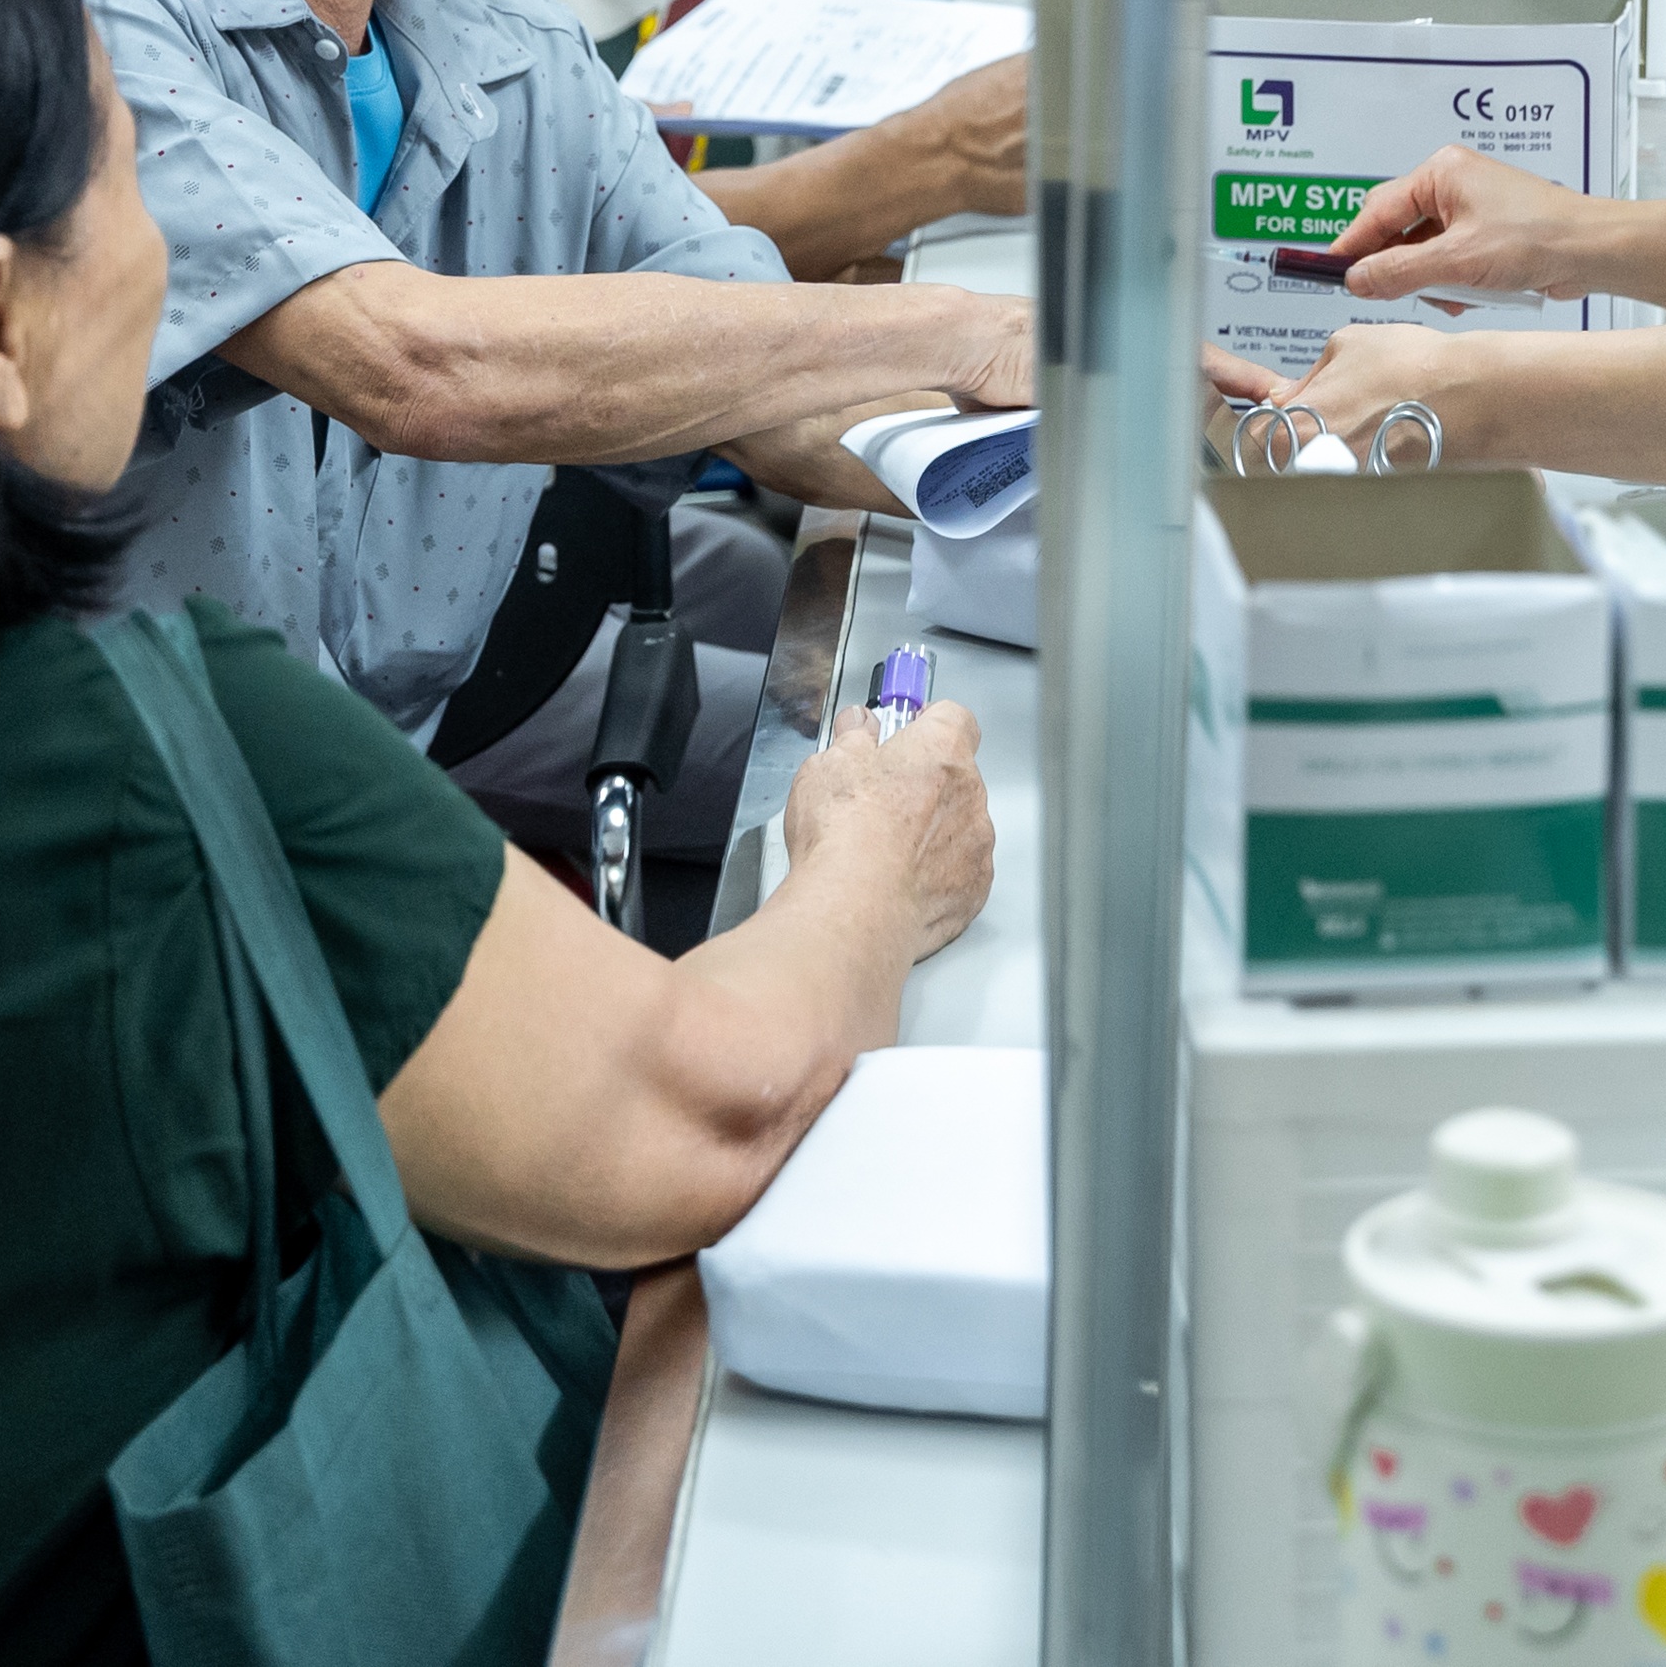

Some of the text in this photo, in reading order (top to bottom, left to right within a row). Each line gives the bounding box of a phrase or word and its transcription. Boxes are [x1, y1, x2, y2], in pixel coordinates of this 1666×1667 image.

[1505, 104, 1555, 122] 0197
[1246, 128, 1290, 142] MPV
[1478, 131, 1495, 140] ISO
[1226, 146, 1314, 159] Safety is health
[1477, 142, 1495, 151] ISO
[1230, 182, 1297, 208] MPV
[1256, 215, 1353, 235] FOR SING
[1235, 325, 1288, 338] VIETNAM
[1233, 342, 1247, 351] Lot
